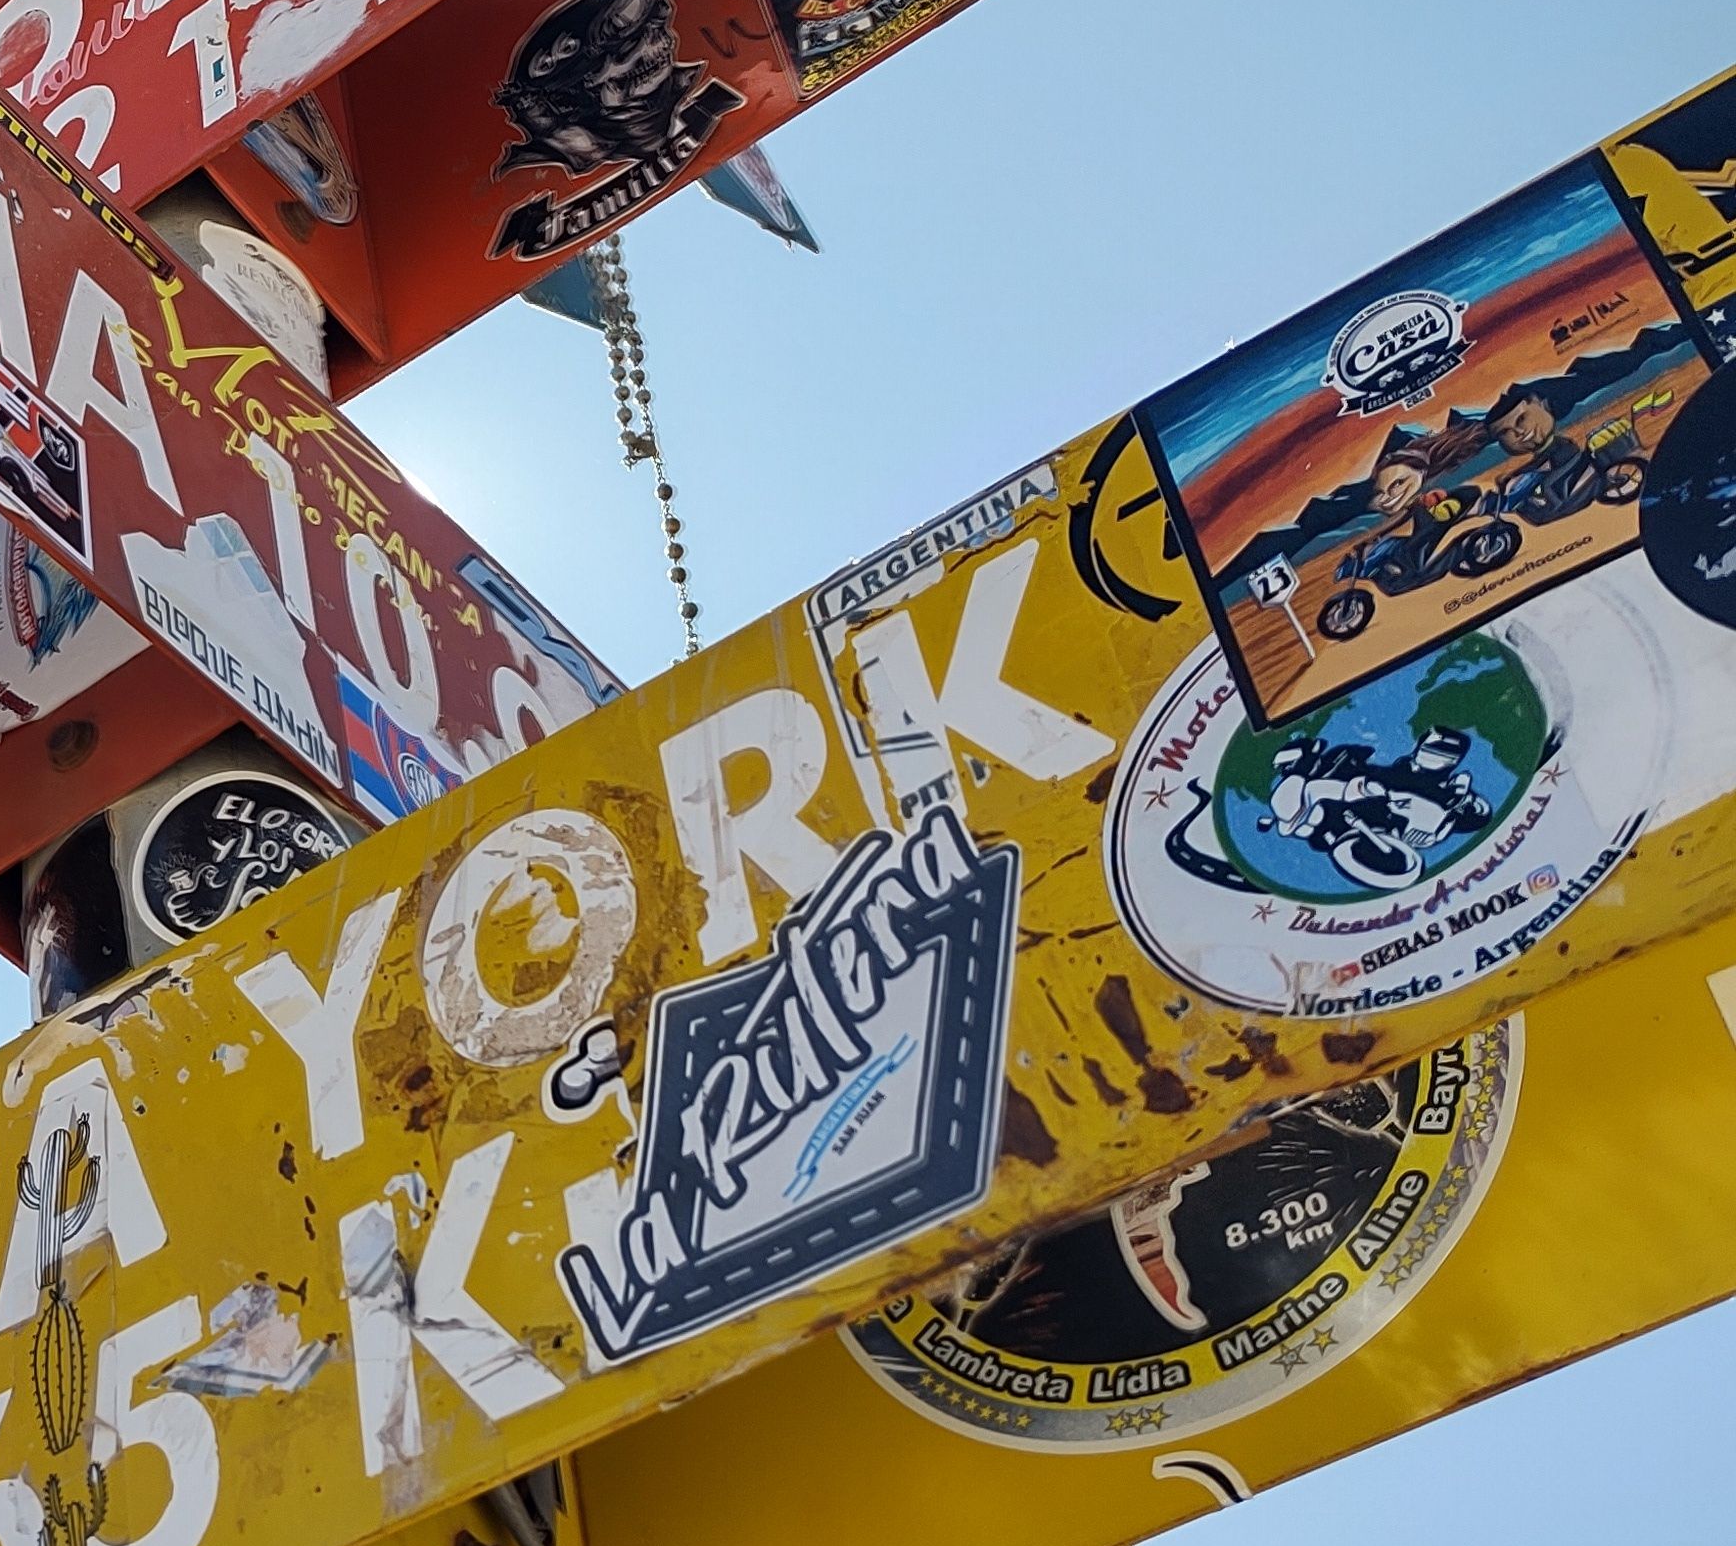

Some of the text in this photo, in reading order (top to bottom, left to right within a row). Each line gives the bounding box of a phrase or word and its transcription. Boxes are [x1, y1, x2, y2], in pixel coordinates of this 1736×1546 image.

[113, 321, 205, 420] San
[1349, 316, 1447, 376] Casa
[834, 472, 1046, 613] ARGENTINA
[1254, 564, 1292, 601] 23
[234, 538, 1116, 1161] YORK
[1288, 902, 1423, 937] Buscando
[1289, 850, 1622, 1019] Nordeste Argentina
[1362, 881, 1529, 975] SEBAS MOOK
[830, 1089, 886, 1157] SAN JUAN
[1223, 1191, 1332, 1250] 8.300
[1285, 1216, 1336, 1251] km
[568, 1191, 688, 1350] La
[916, 1170, 1426, 1404] Lambreta Lídia Marine Aline
